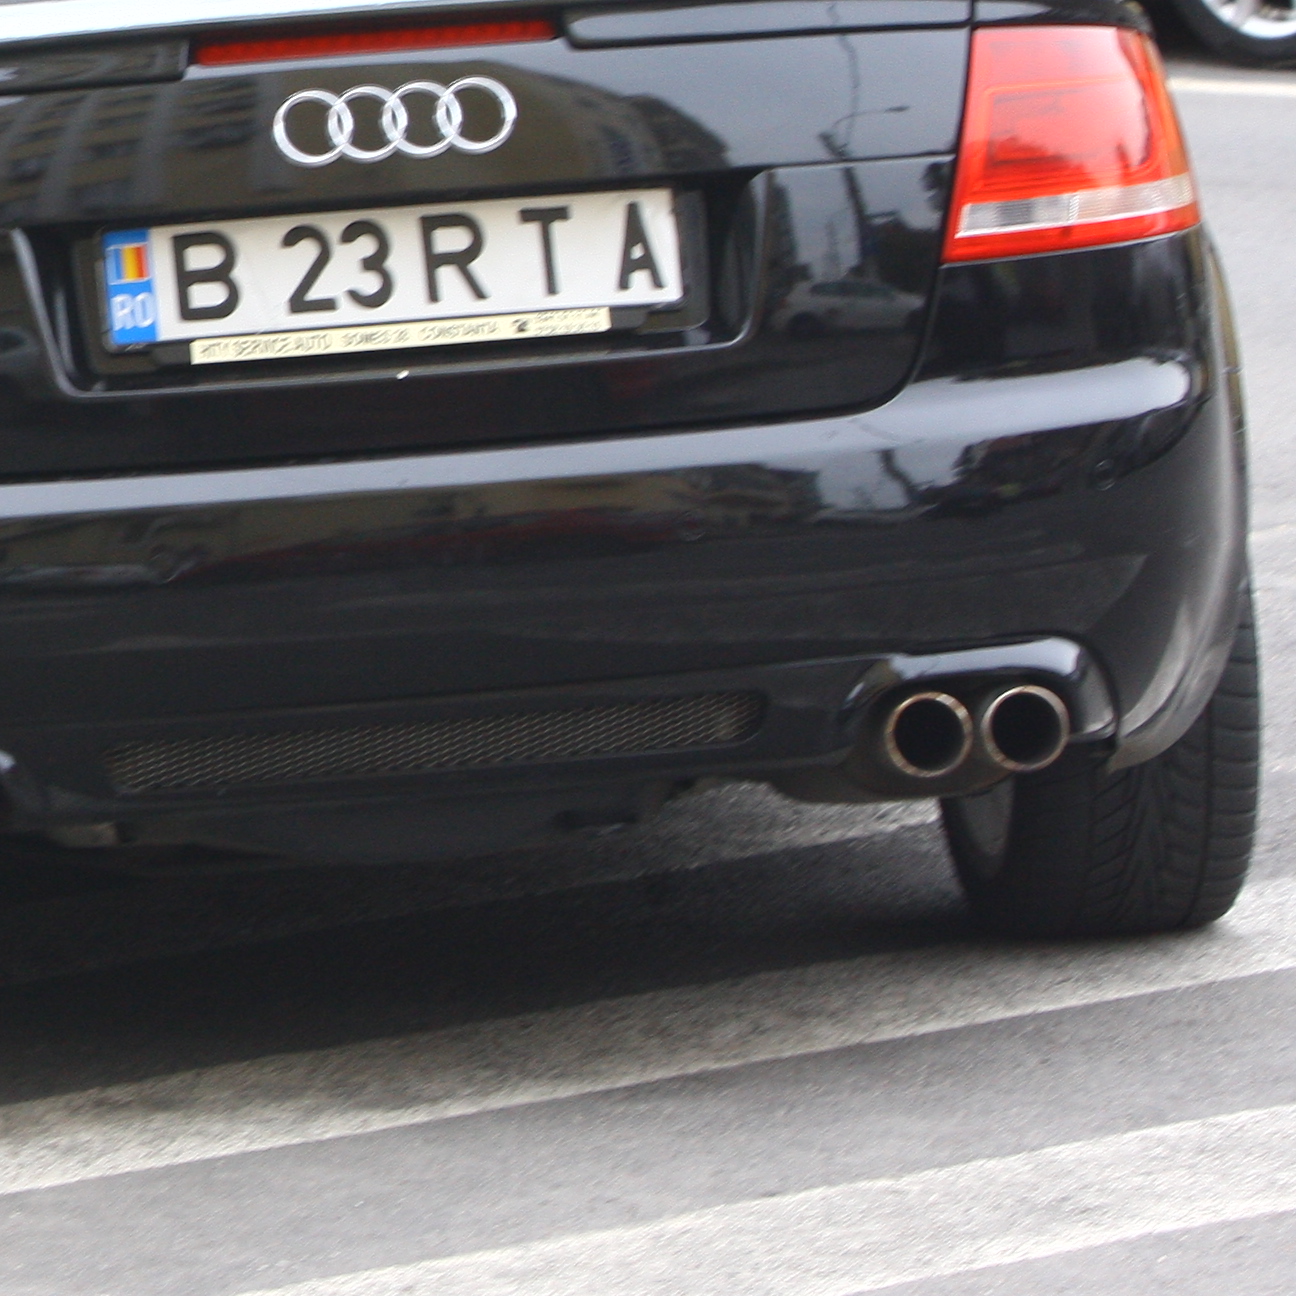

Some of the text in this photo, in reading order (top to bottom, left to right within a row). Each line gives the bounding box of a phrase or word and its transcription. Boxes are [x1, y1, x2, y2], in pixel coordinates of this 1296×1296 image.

[173, 231, 240, 322] B
[281, 219, 394, 314] 23
[110, 292, 156, 331] RO
